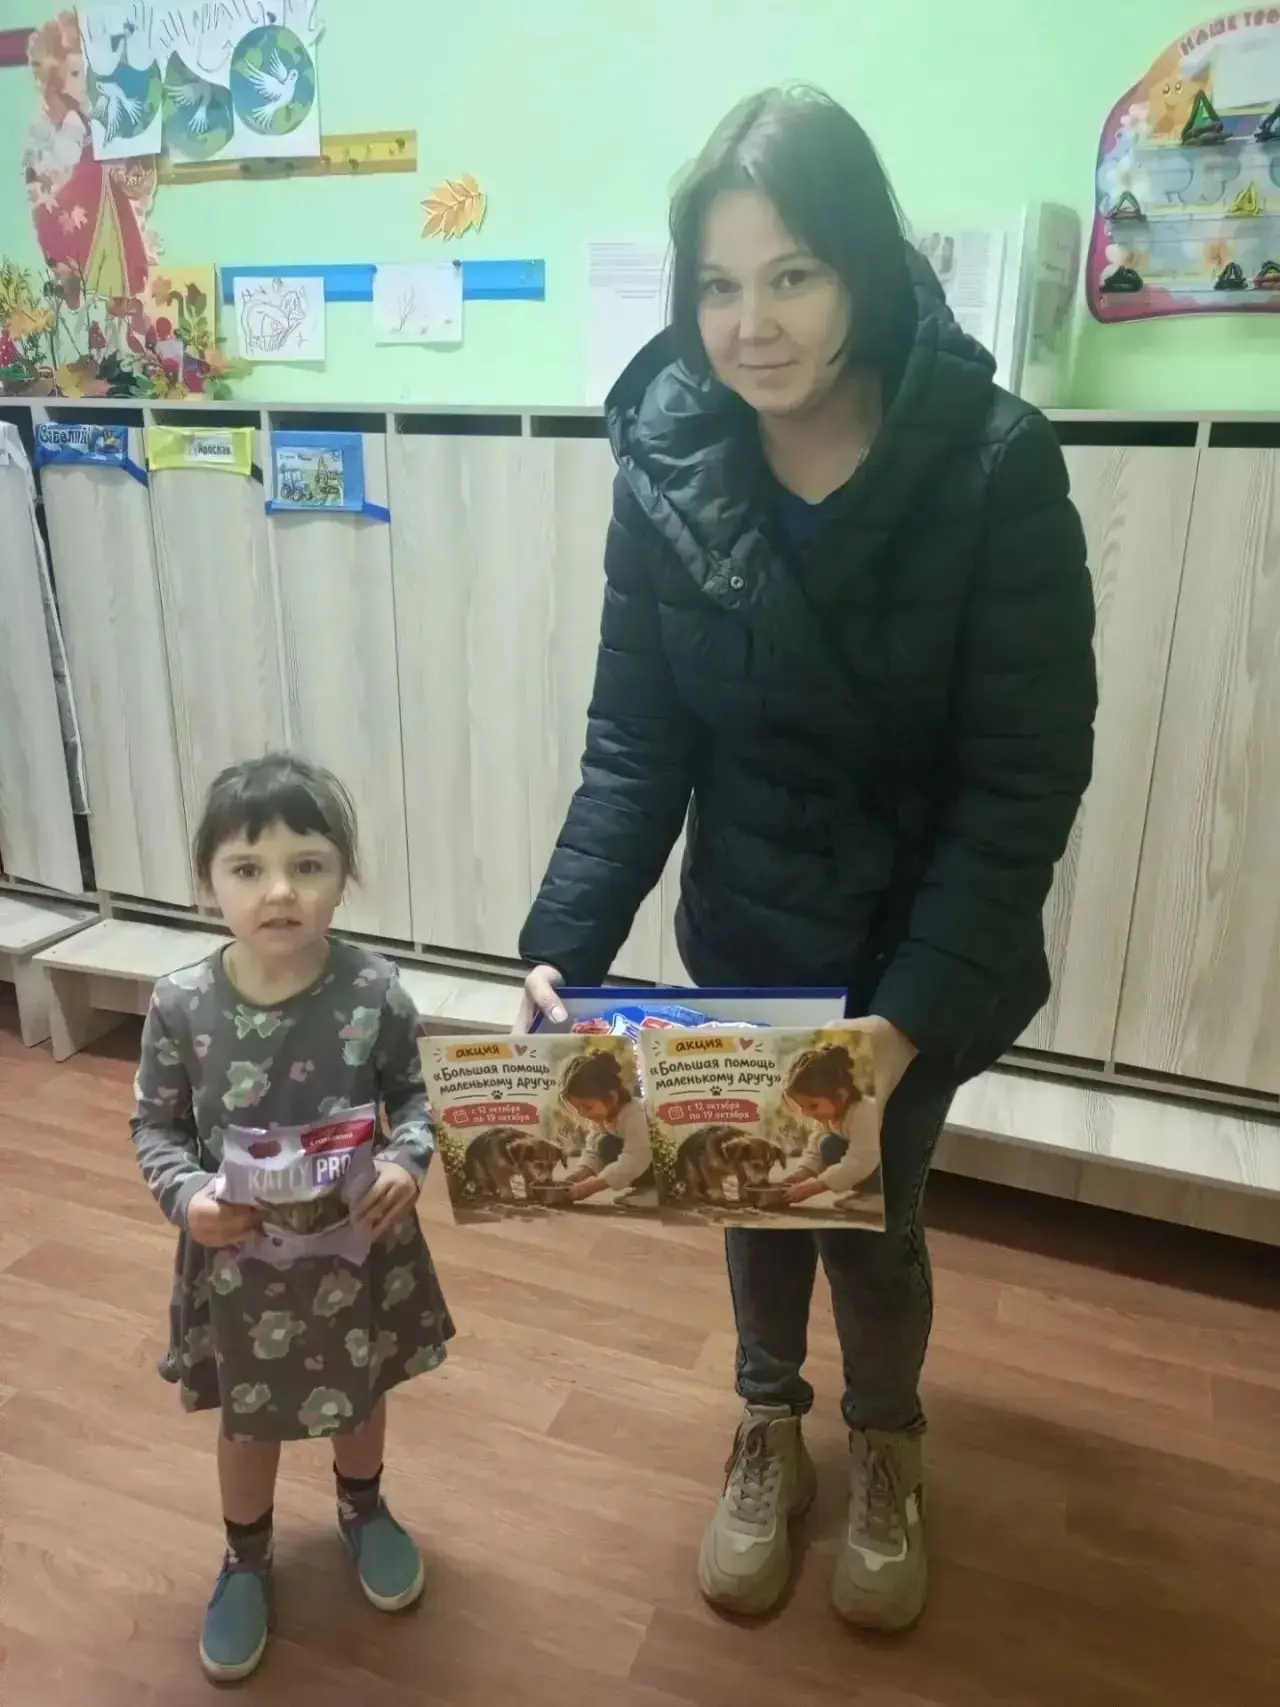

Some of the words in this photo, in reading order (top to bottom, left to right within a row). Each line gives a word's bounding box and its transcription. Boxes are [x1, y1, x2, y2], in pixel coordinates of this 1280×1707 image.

[1179, 15, 1238, 57] НАШЕ
[455, 1044, 501, 1059] акция
[675, 1038, 724, 1053] акция
[433, 1064, 498, 1082] «Большая
[502, 1063, 550, 1075] помощь
[649, 1058, 719, 1077] «Большая
[724, 1057, 776, 1071] помощь
[440, 1077, 513, 1096] маленькому
[517, 1077, 557, 1091] другу»
[655, 1072, 734, 1091] маленькому
[738, 1072, 782, 1088] другу»
[706, 1100, 740, 1111] октября
[715, 1109, 751, 1121] октября
[316, 1153, 352, 1183] PRO
